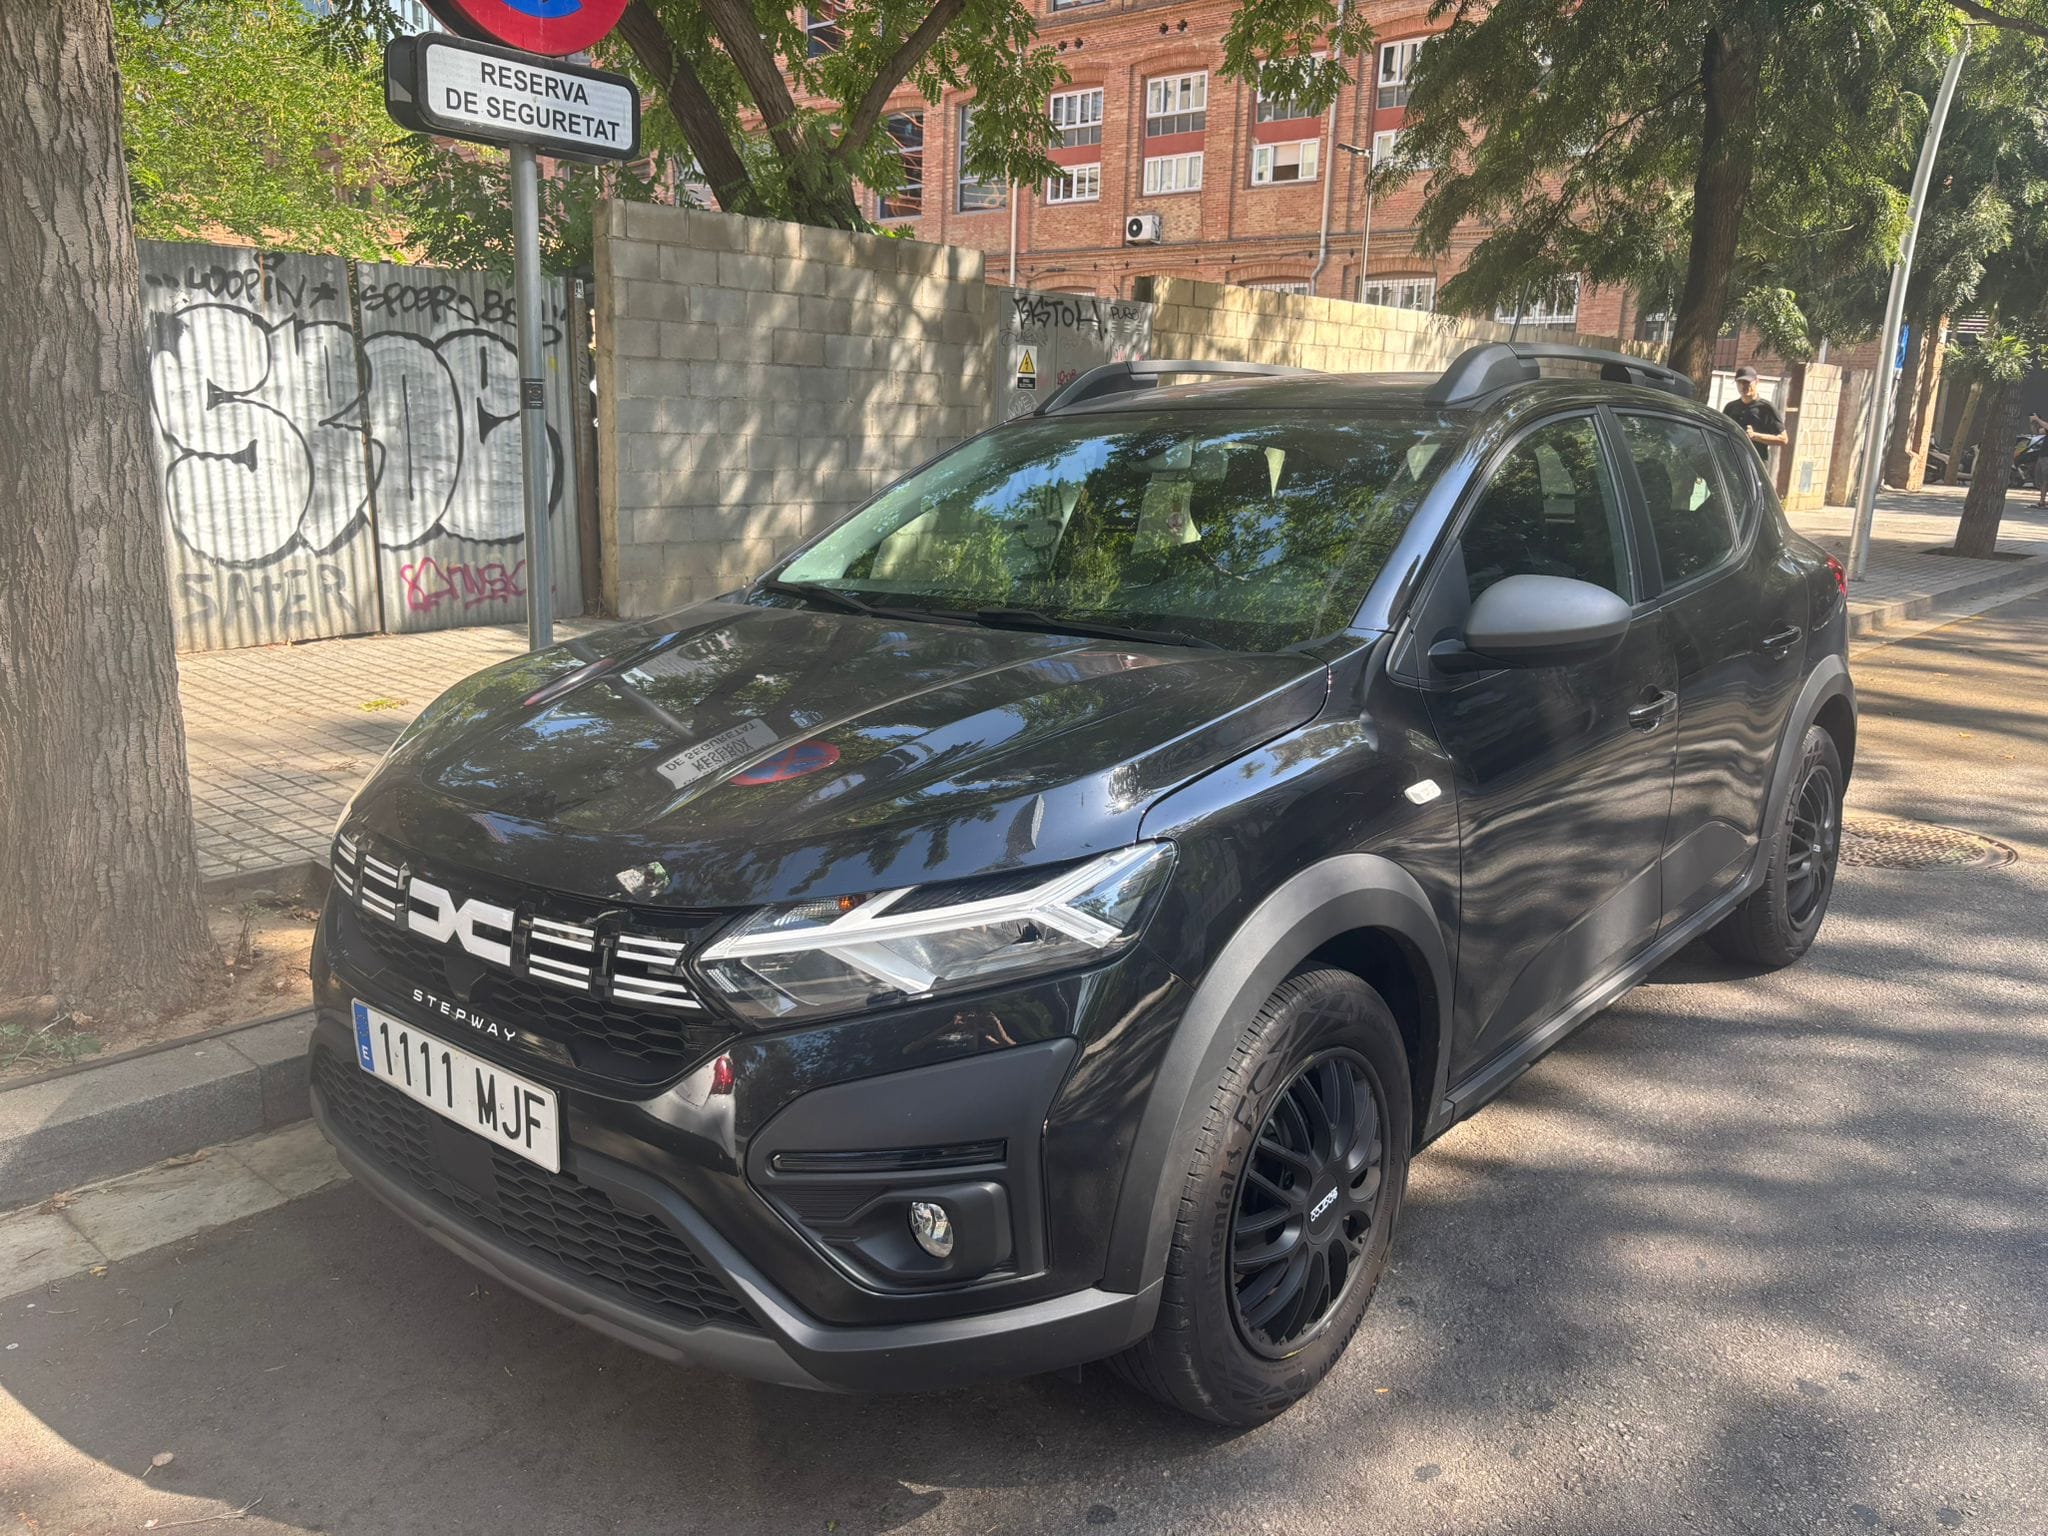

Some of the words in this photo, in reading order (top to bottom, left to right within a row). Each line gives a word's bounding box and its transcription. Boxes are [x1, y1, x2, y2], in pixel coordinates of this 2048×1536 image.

[481, 61, 589, 105] RESERVA
[446, 87, 479, 115] DE
[486, 96, 620, 142] SEGURETAT
[412, 988, 517, 1041] STEPWAY
[362, 1045, 370, 1061] E
[379, 1022, 454, 1108] 1111
[475, 1067, 546, 1148] MJF
